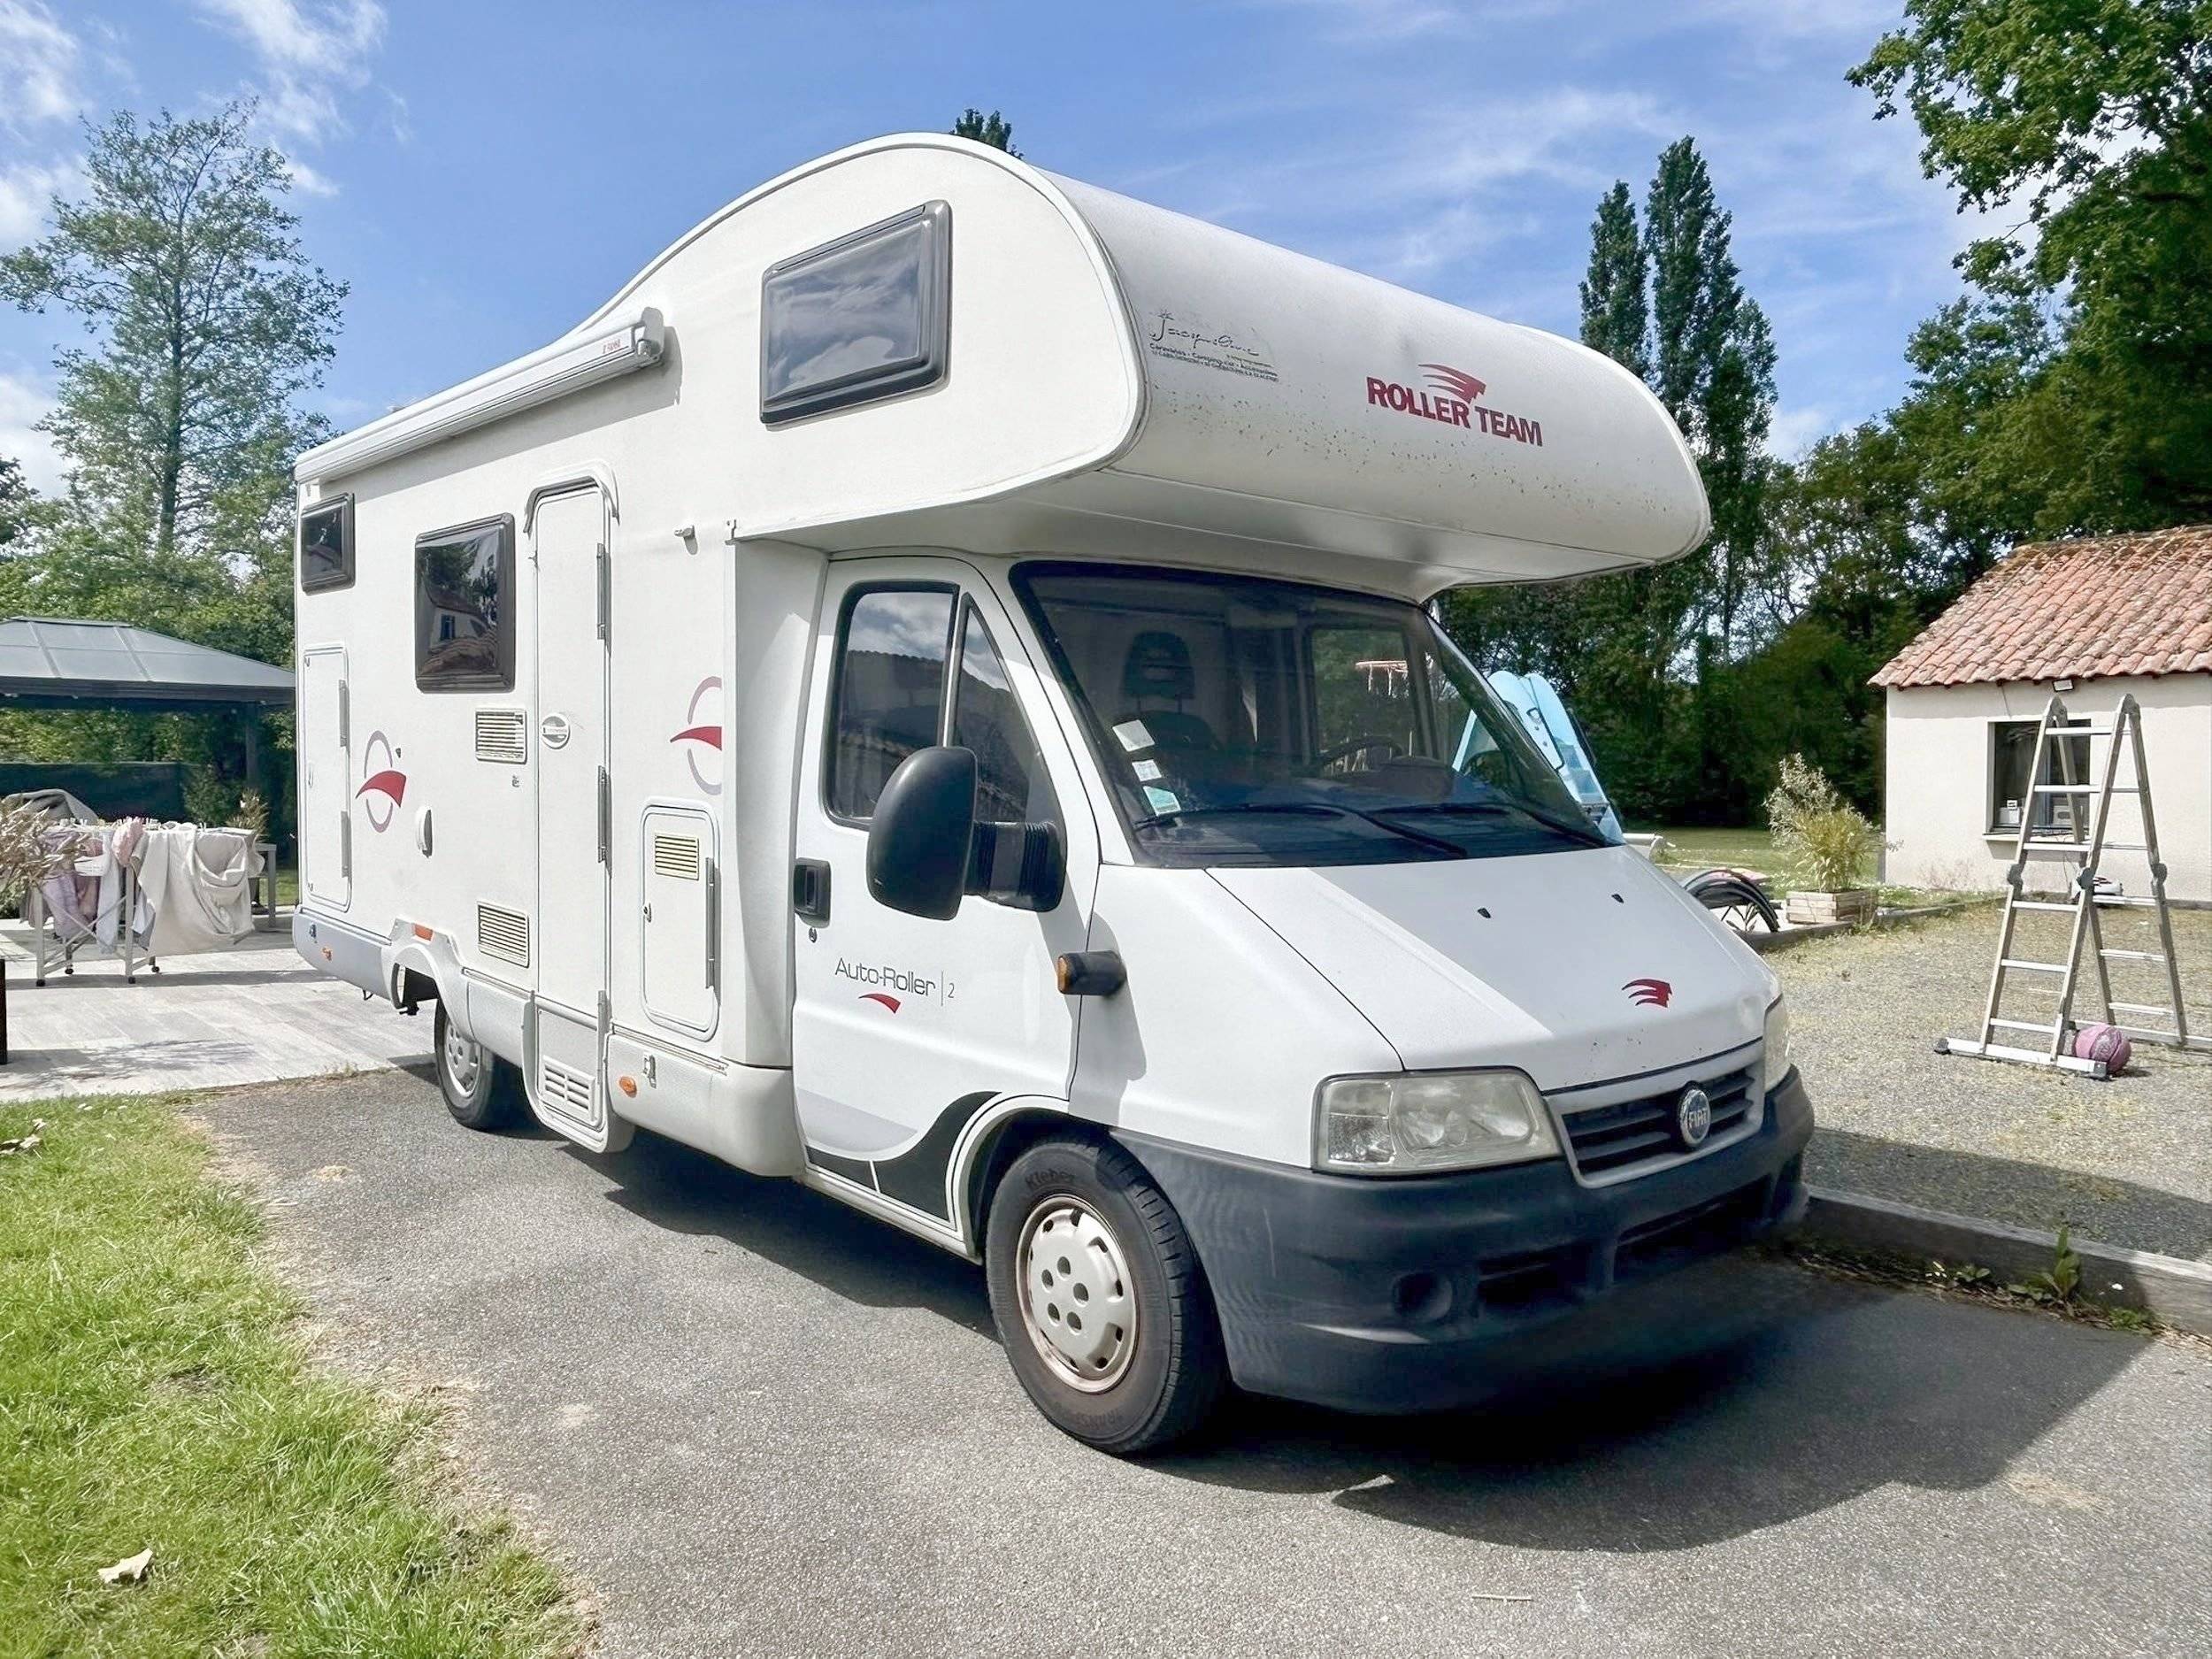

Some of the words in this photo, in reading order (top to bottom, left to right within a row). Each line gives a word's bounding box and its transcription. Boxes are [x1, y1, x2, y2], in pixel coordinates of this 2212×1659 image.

[1366, 376, 1471, 429] ROLLER
[1474, 405, 1543, 447] TEAM
[834, 957, 936, 996] Auto-Roller
[948, 982, 955, 998] 2
[1688, 1106, 1709, 1129] FIAT
